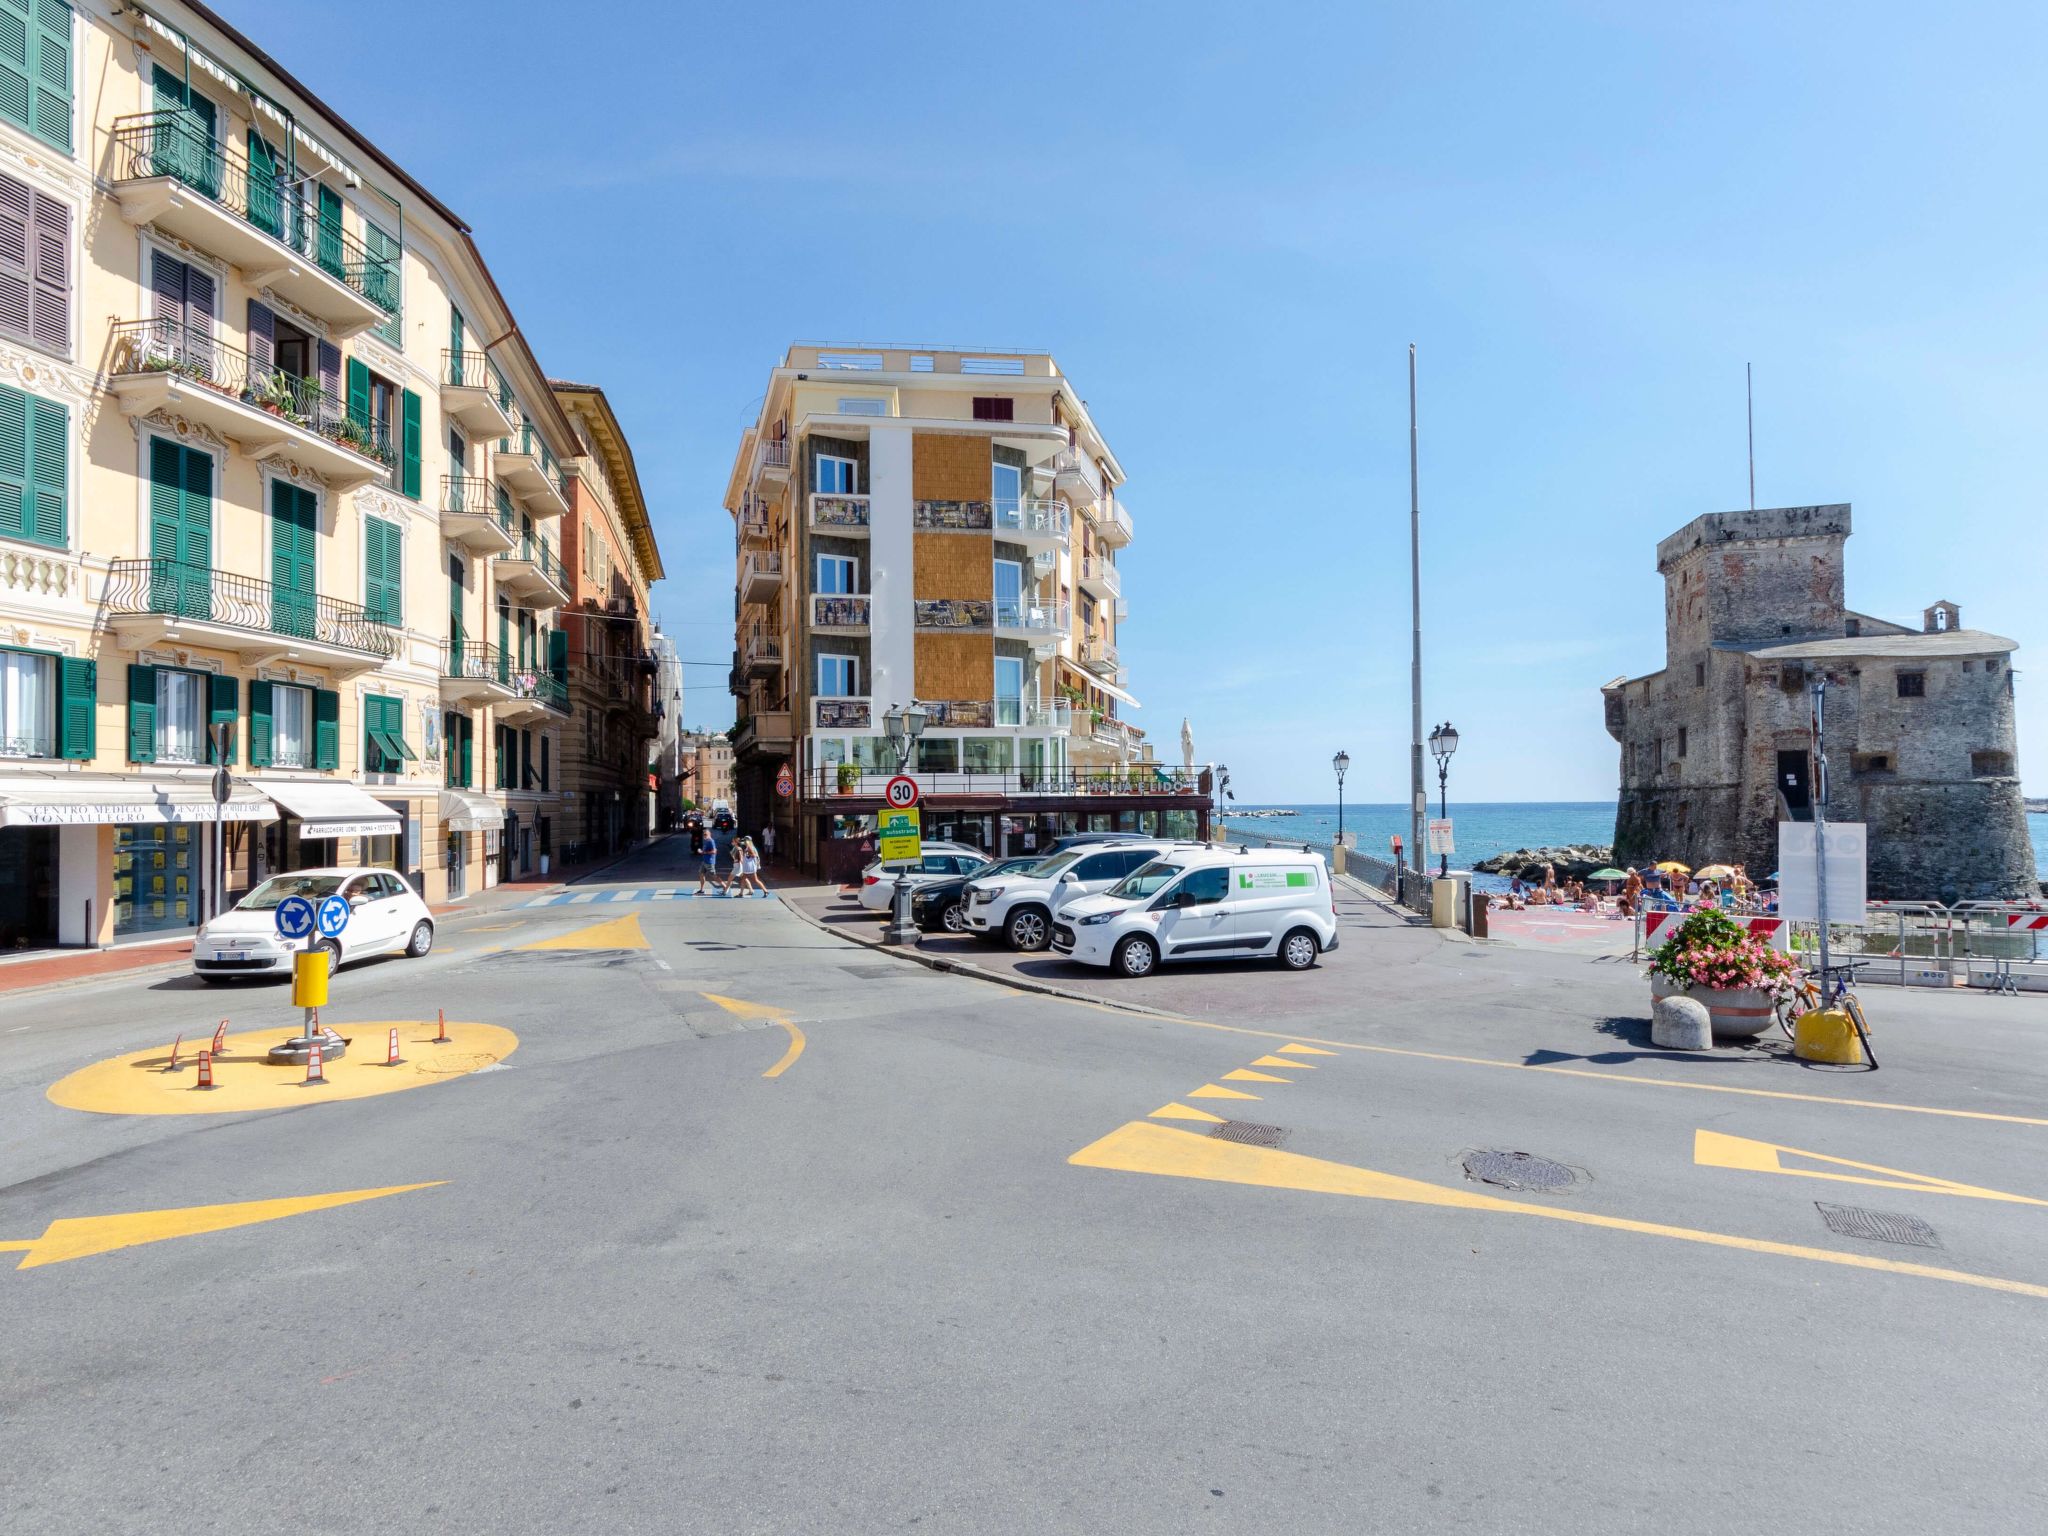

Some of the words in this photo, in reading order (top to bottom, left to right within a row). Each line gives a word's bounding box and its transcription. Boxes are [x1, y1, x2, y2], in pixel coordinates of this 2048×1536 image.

[1086, 781, 1132, 792] ITALIA
[1138, 781, 1145, 792] E
[1149, 780, 1184, 792] LIDO
[893, 785, 910, 800] 30
[33, 805, 88, 815] CENTRO
[93, 804, 142, 814] MEDICO
[28, 813, 145, 824] MONTALLEGRO
